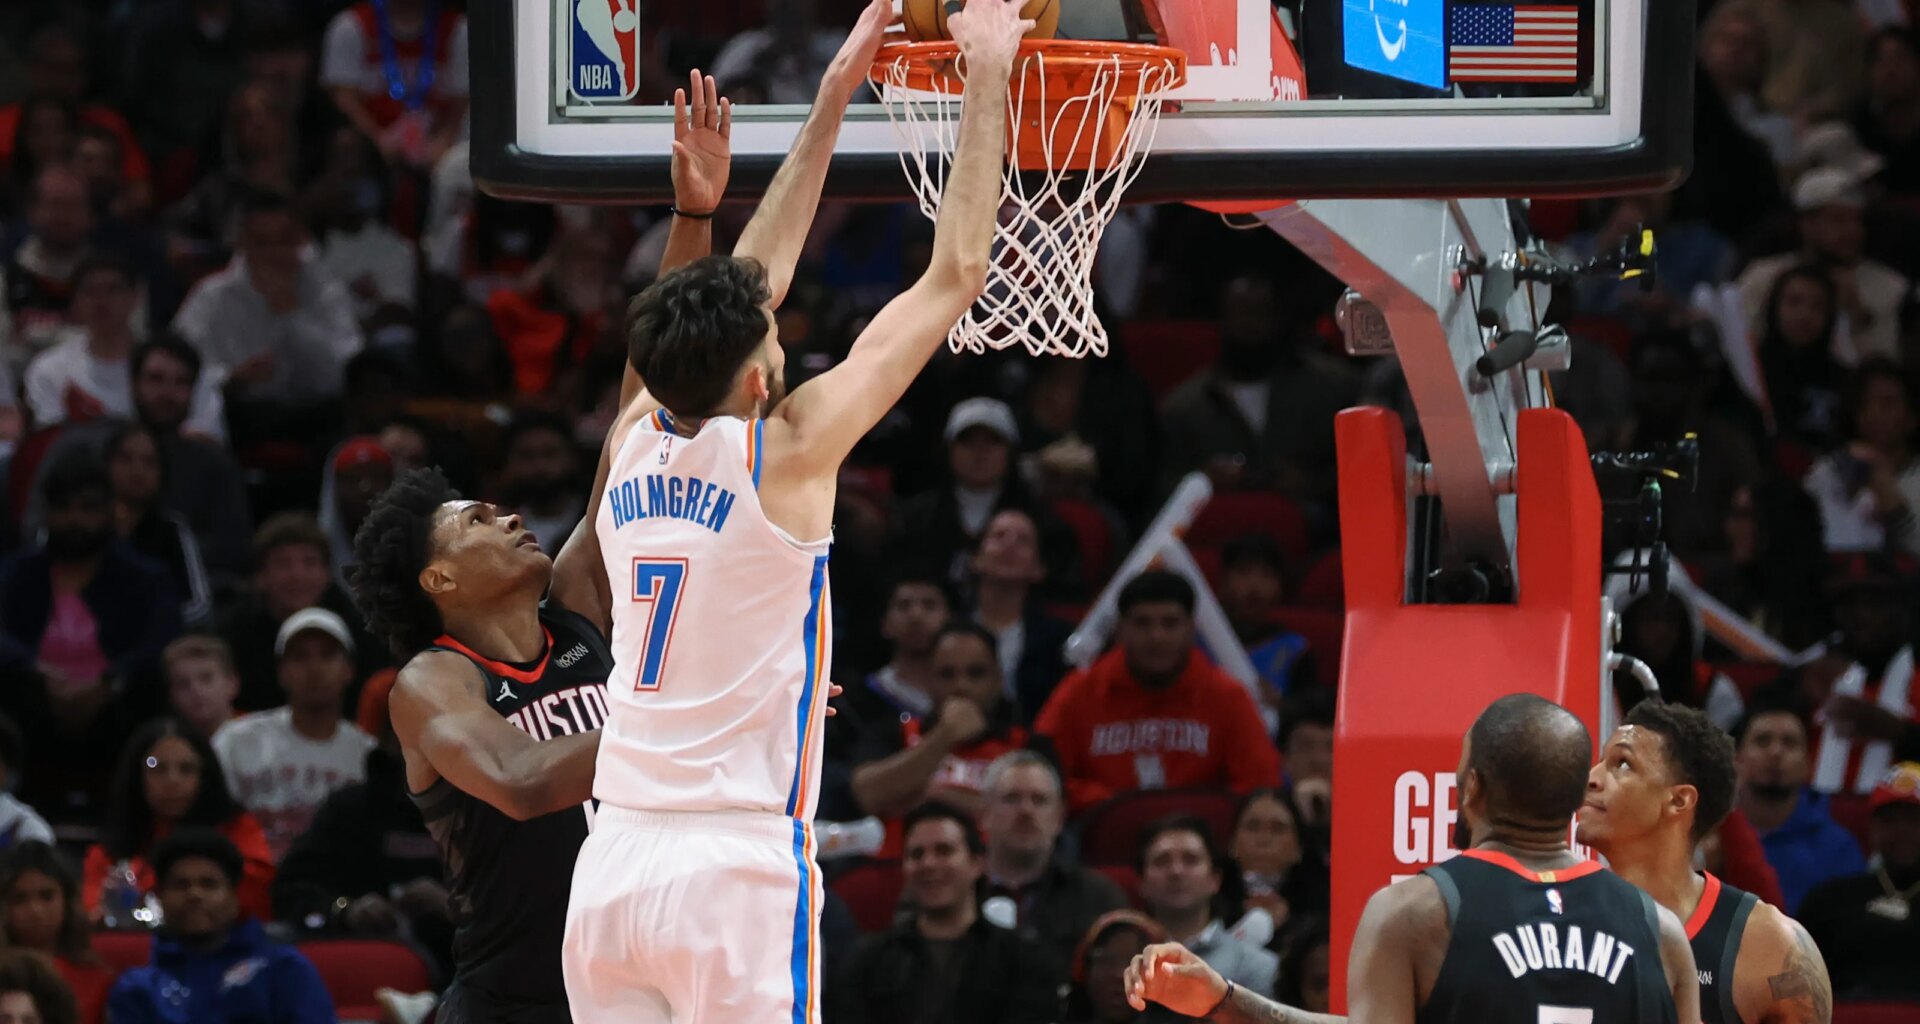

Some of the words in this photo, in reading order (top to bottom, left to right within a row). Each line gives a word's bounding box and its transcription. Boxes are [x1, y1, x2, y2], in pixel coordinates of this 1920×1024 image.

[580, 64, 612, 90] NBA
[1271, 75, 1300, 101] arm
[608, 475, 736, 533] HOLMGREN
[632, 557, 688, 691] 7
[1393, 770, 1463, 864] GE
[1491, 922, 1635, 985] DURANT
